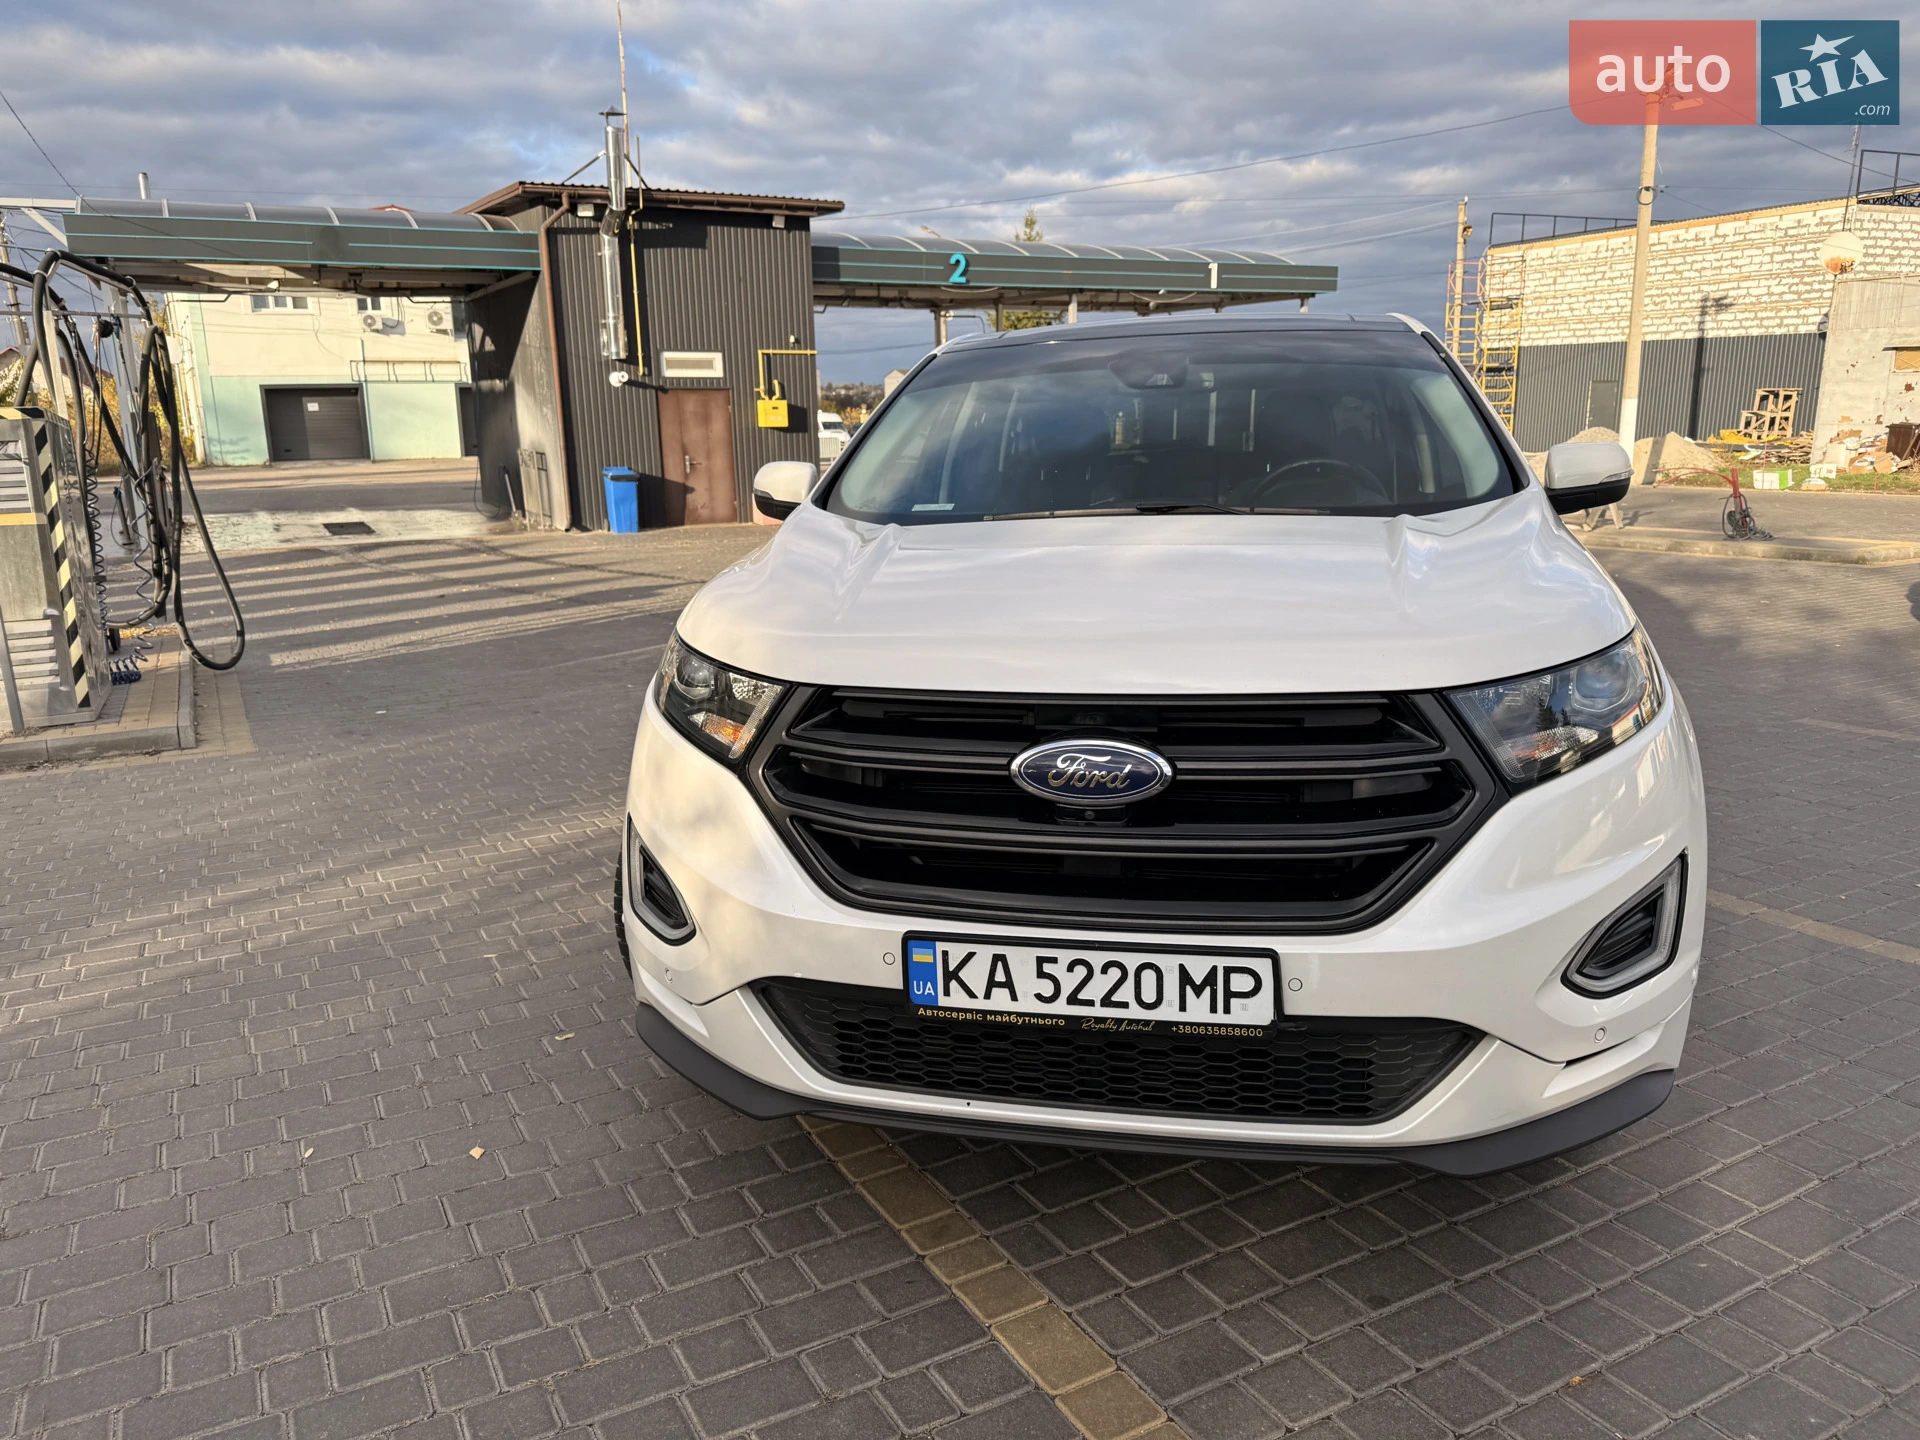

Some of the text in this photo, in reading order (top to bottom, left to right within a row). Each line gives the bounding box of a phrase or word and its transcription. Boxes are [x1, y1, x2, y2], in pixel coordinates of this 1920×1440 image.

[949, 253, 967, 284] 2
[1208, 263, 1218, 289] 1
[1048, 753, 1132, 788] Ford
[914, 981, 935, 996] UA
[1033, 956, 1164, 1010] 5220
[918, 1007, 1065, 1026] Автосервіс майбутнього
[1171, 1025, 1263, 1037] +380635858600
